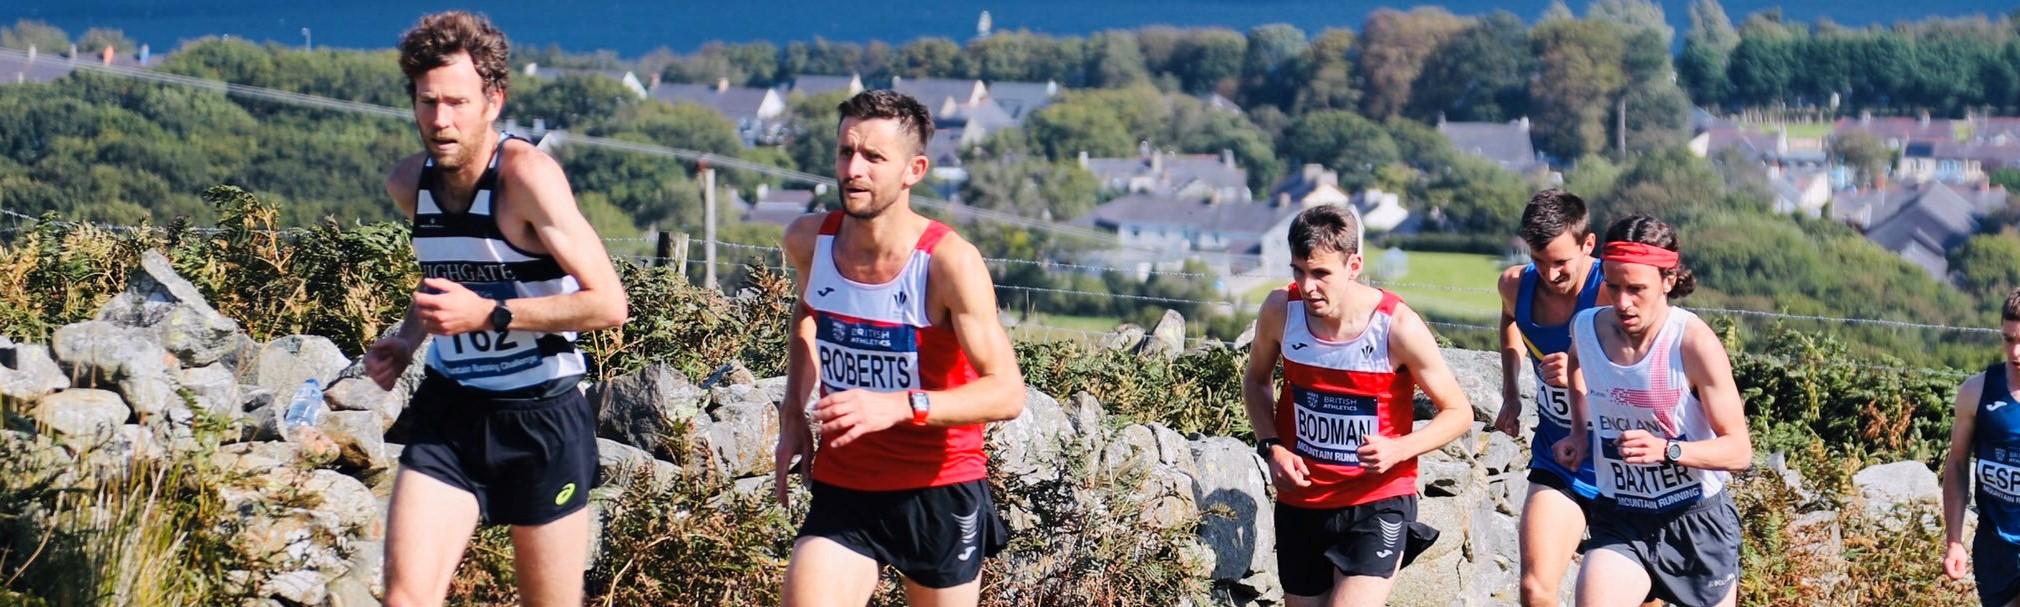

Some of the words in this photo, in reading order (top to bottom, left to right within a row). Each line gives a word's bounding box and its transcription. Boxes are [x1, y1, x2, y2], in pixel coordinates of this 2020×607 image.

[851, 338, 891, 347] ATHLETICS
[852, 328, 890, 339] BRITISH
[820, 345, 911, 389] ROBERTS
[1322, 403, 1358, 411] ATHLETICS
[1323, 396, 1358, 405] BRITISH
[1541, 385, 1569, 416] 15
[1298, 409, 1371, 446] BODMAN
[1297, 441, 1333, 460] MOUNTAIN
[1611, 463, 1693, 494] BAXTER
[1617, 496, 1658, 510] MOUNTAIN
[1658, 488, 1700, 508] RUNNING
